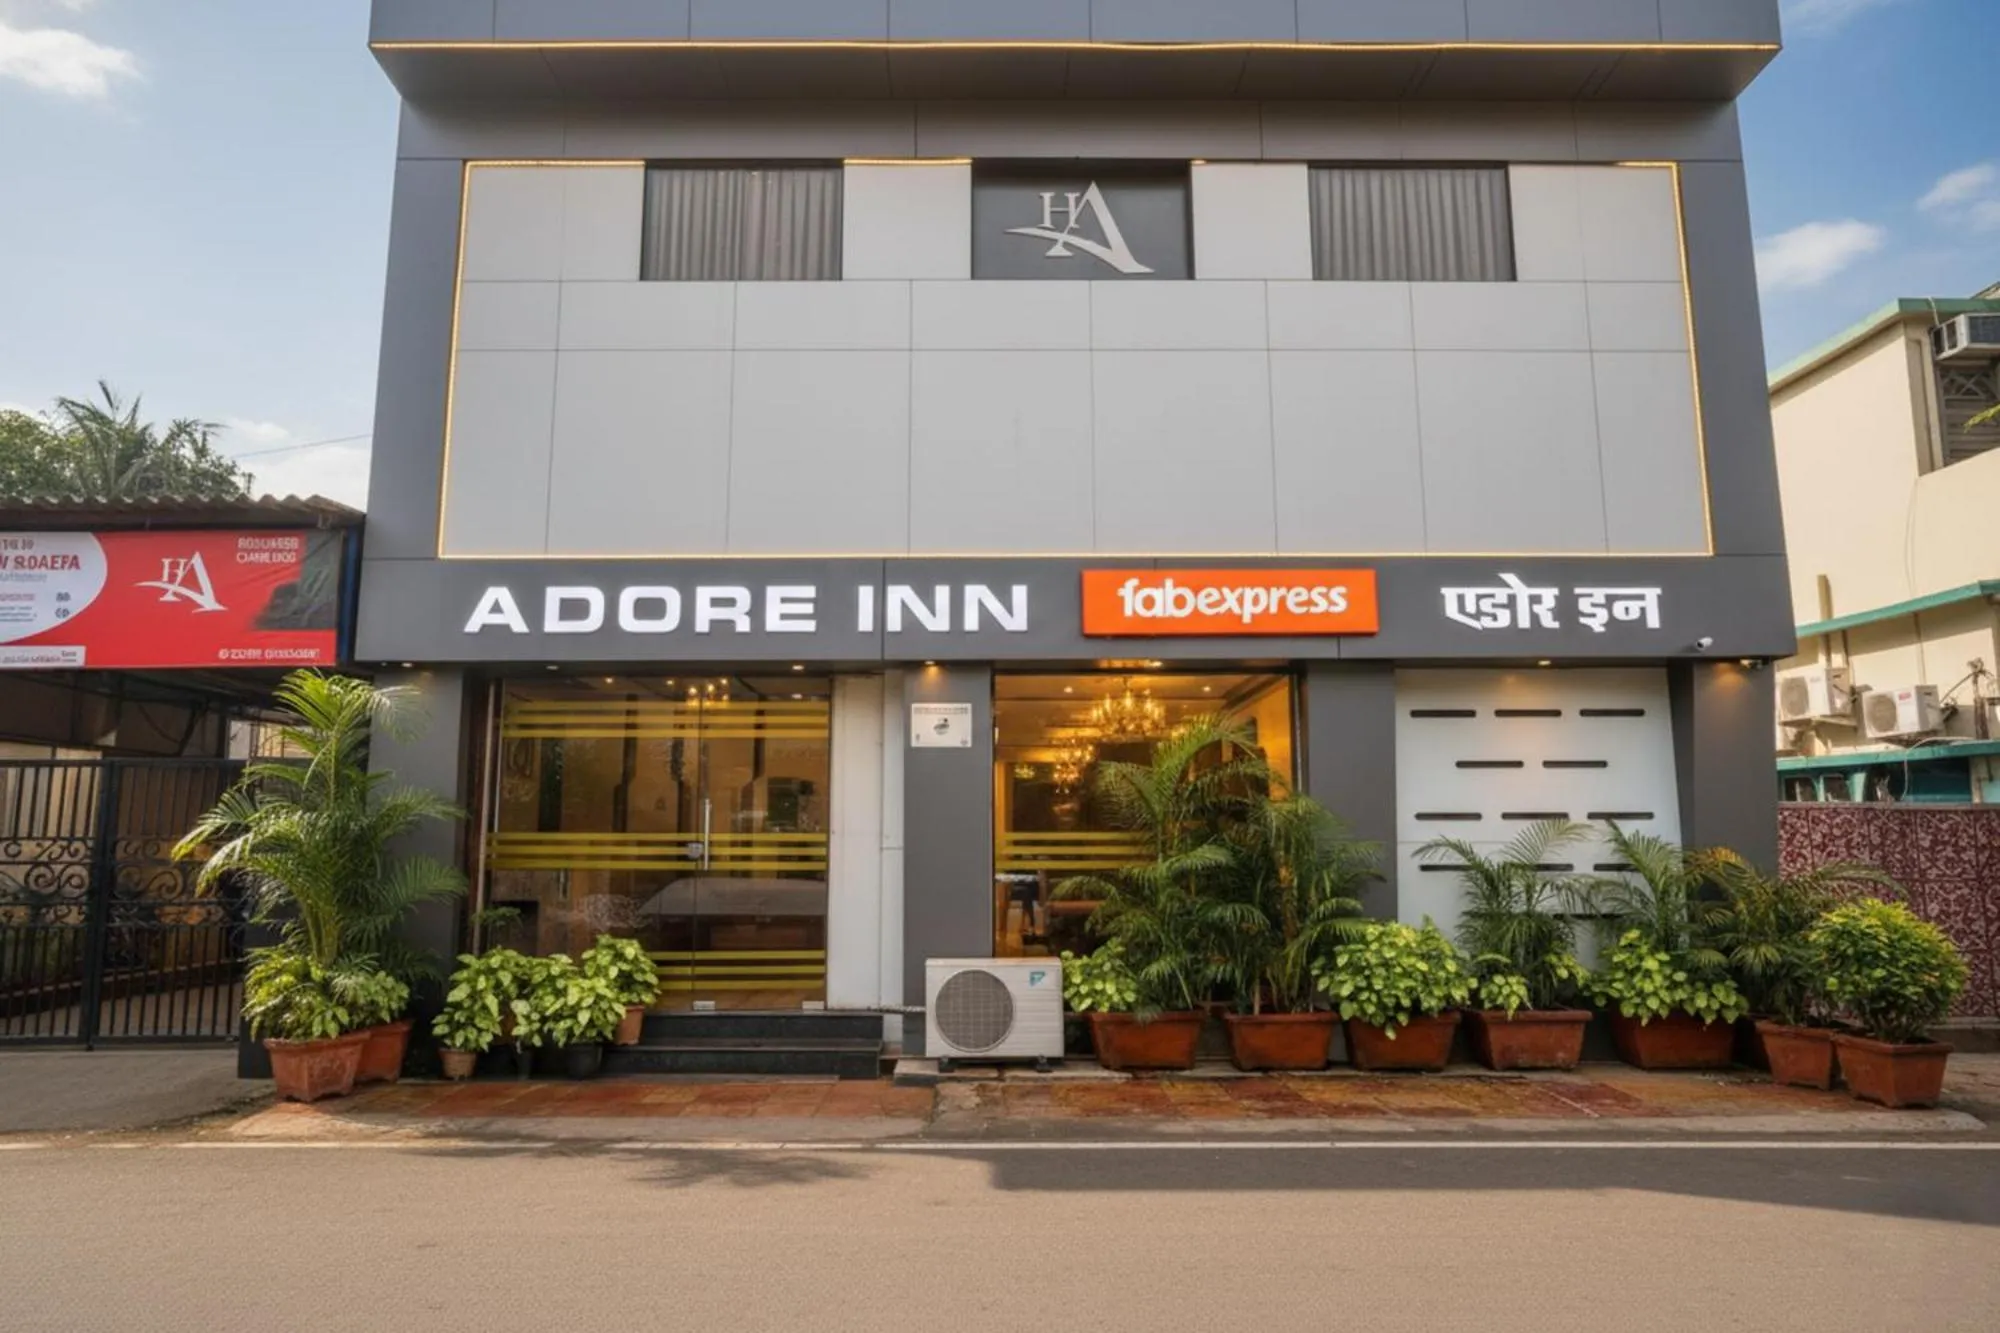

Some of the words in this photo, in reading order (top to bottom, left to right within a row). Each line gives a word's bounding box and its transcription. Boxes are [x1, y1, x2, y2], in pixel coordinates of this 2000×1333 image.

[464, 585, 816, 633] ADORE
[857, 584, 1027, 632] INN
[1117, 578, 1348, 623] fabexpress
[1440, 573, 1560, 630] एडोर
[1573, 587, 1662, 632] इन
